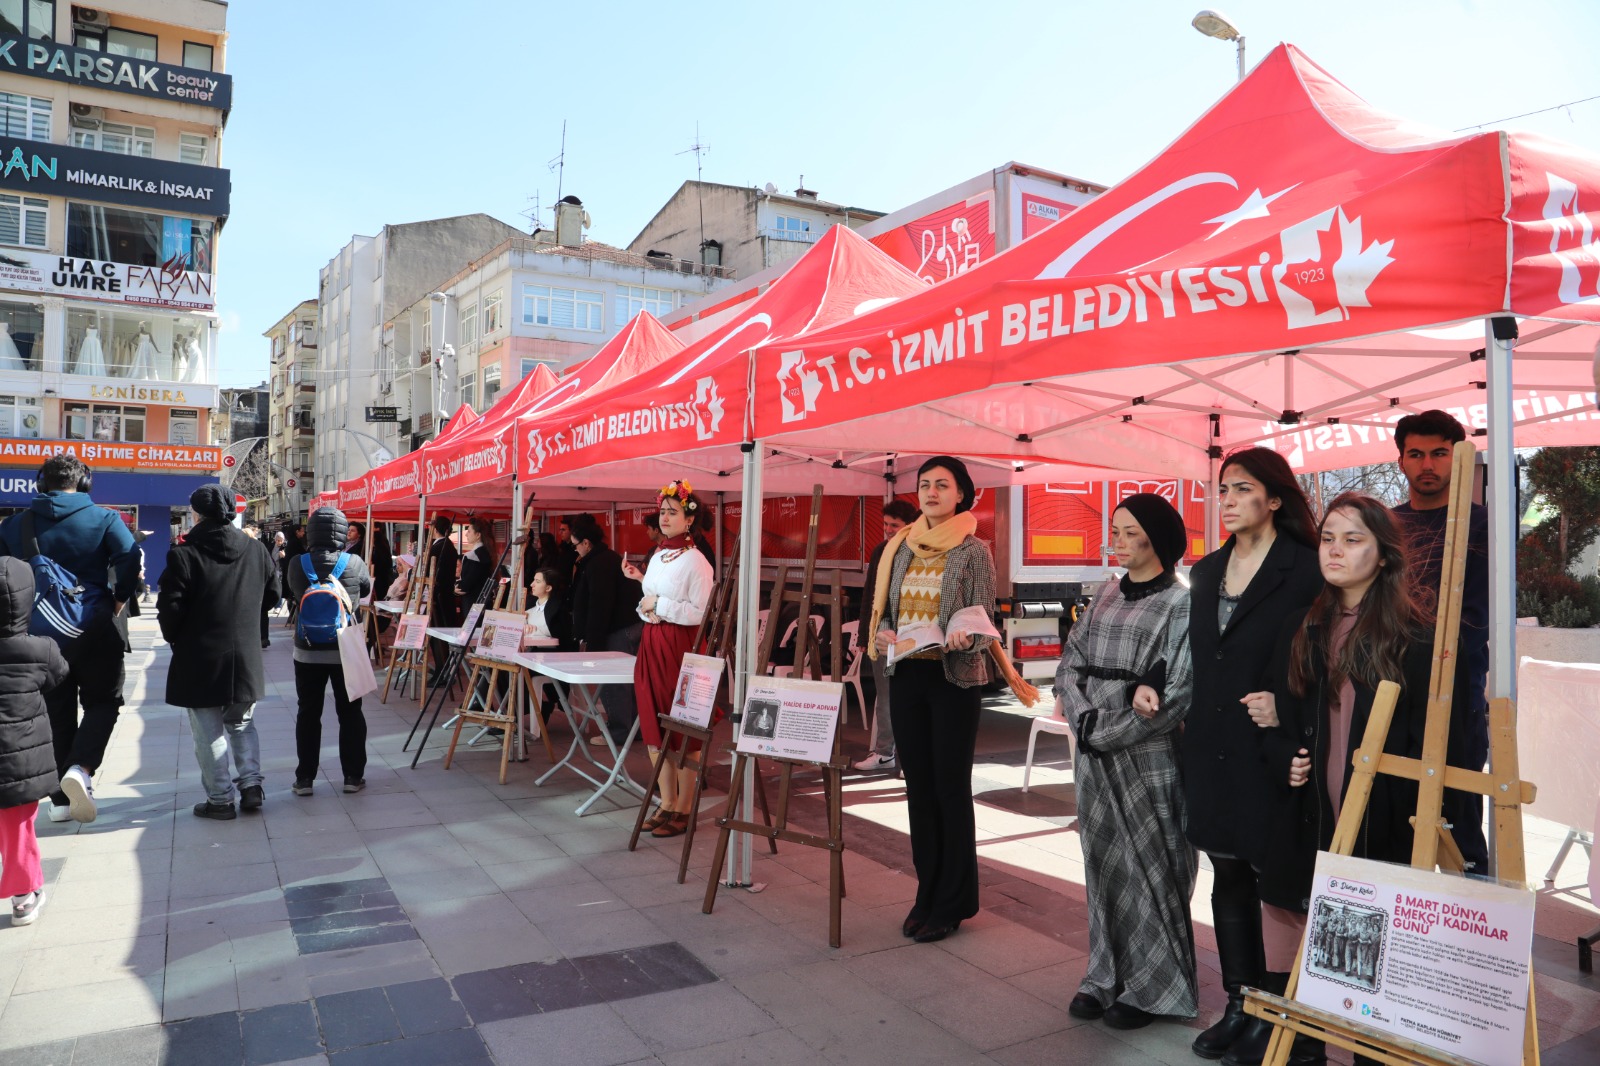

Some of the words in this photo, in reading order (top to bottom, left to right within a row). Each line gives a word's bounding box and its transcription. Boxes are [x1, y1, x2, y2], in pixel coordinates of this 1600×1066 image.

[27, 43, 159, 92] PARSAK
[167, 71, 218, 91] beauty
[166, 84, 213, 101] center
[0, 146, 57, 181] AN
[66, 169, 144, 191] MİMARLIK
[144, 181, 158, 193] &
[160, 180, 213, 200] İNŞAAT
[1039, 205, 1058, 216] ALKAN
[59, 257, 115, 277] HAC
[1293, 267, 1325, 285] 1923
[52, 272, 121, 292] UMRE
[817, 347, 885, 392] T.C.
[887, 307, 989, 375] İZMİT
[1001, 251, 1268, 346] BELEDİYESİ
[91, 384, 186, 402] LONİSERA
[569, 414, 605, 450] İZMİT
[607, 394, 695, 440] BELEDİYESİ
[0, 443, 76, 458] ARMARA
[82, 444, 134, 461] İŞİTME
[138, 446, 218, 462] CİHAZLARI
[448, 454, 465, 478] İZMİT
[464, 445, 498, 472] BELEDİYESİ
[783, 700, 802, 709] HALİDE
[1395, 894, 1402, 904] 8
[1405, 896, 1439, 912] MART
[1442, 903, 1487, 923] DÜNYA
[1393, 917, 1430, 935] GÜNÜ
[1394, 906, 1440, 926] EMEKÇİ
[1444, 916, 1508, 942] KADINLAR
[1400, 1016, 1416, 1025] FATMA
[1416, 1022, 1436, 1032] KAPLAN
